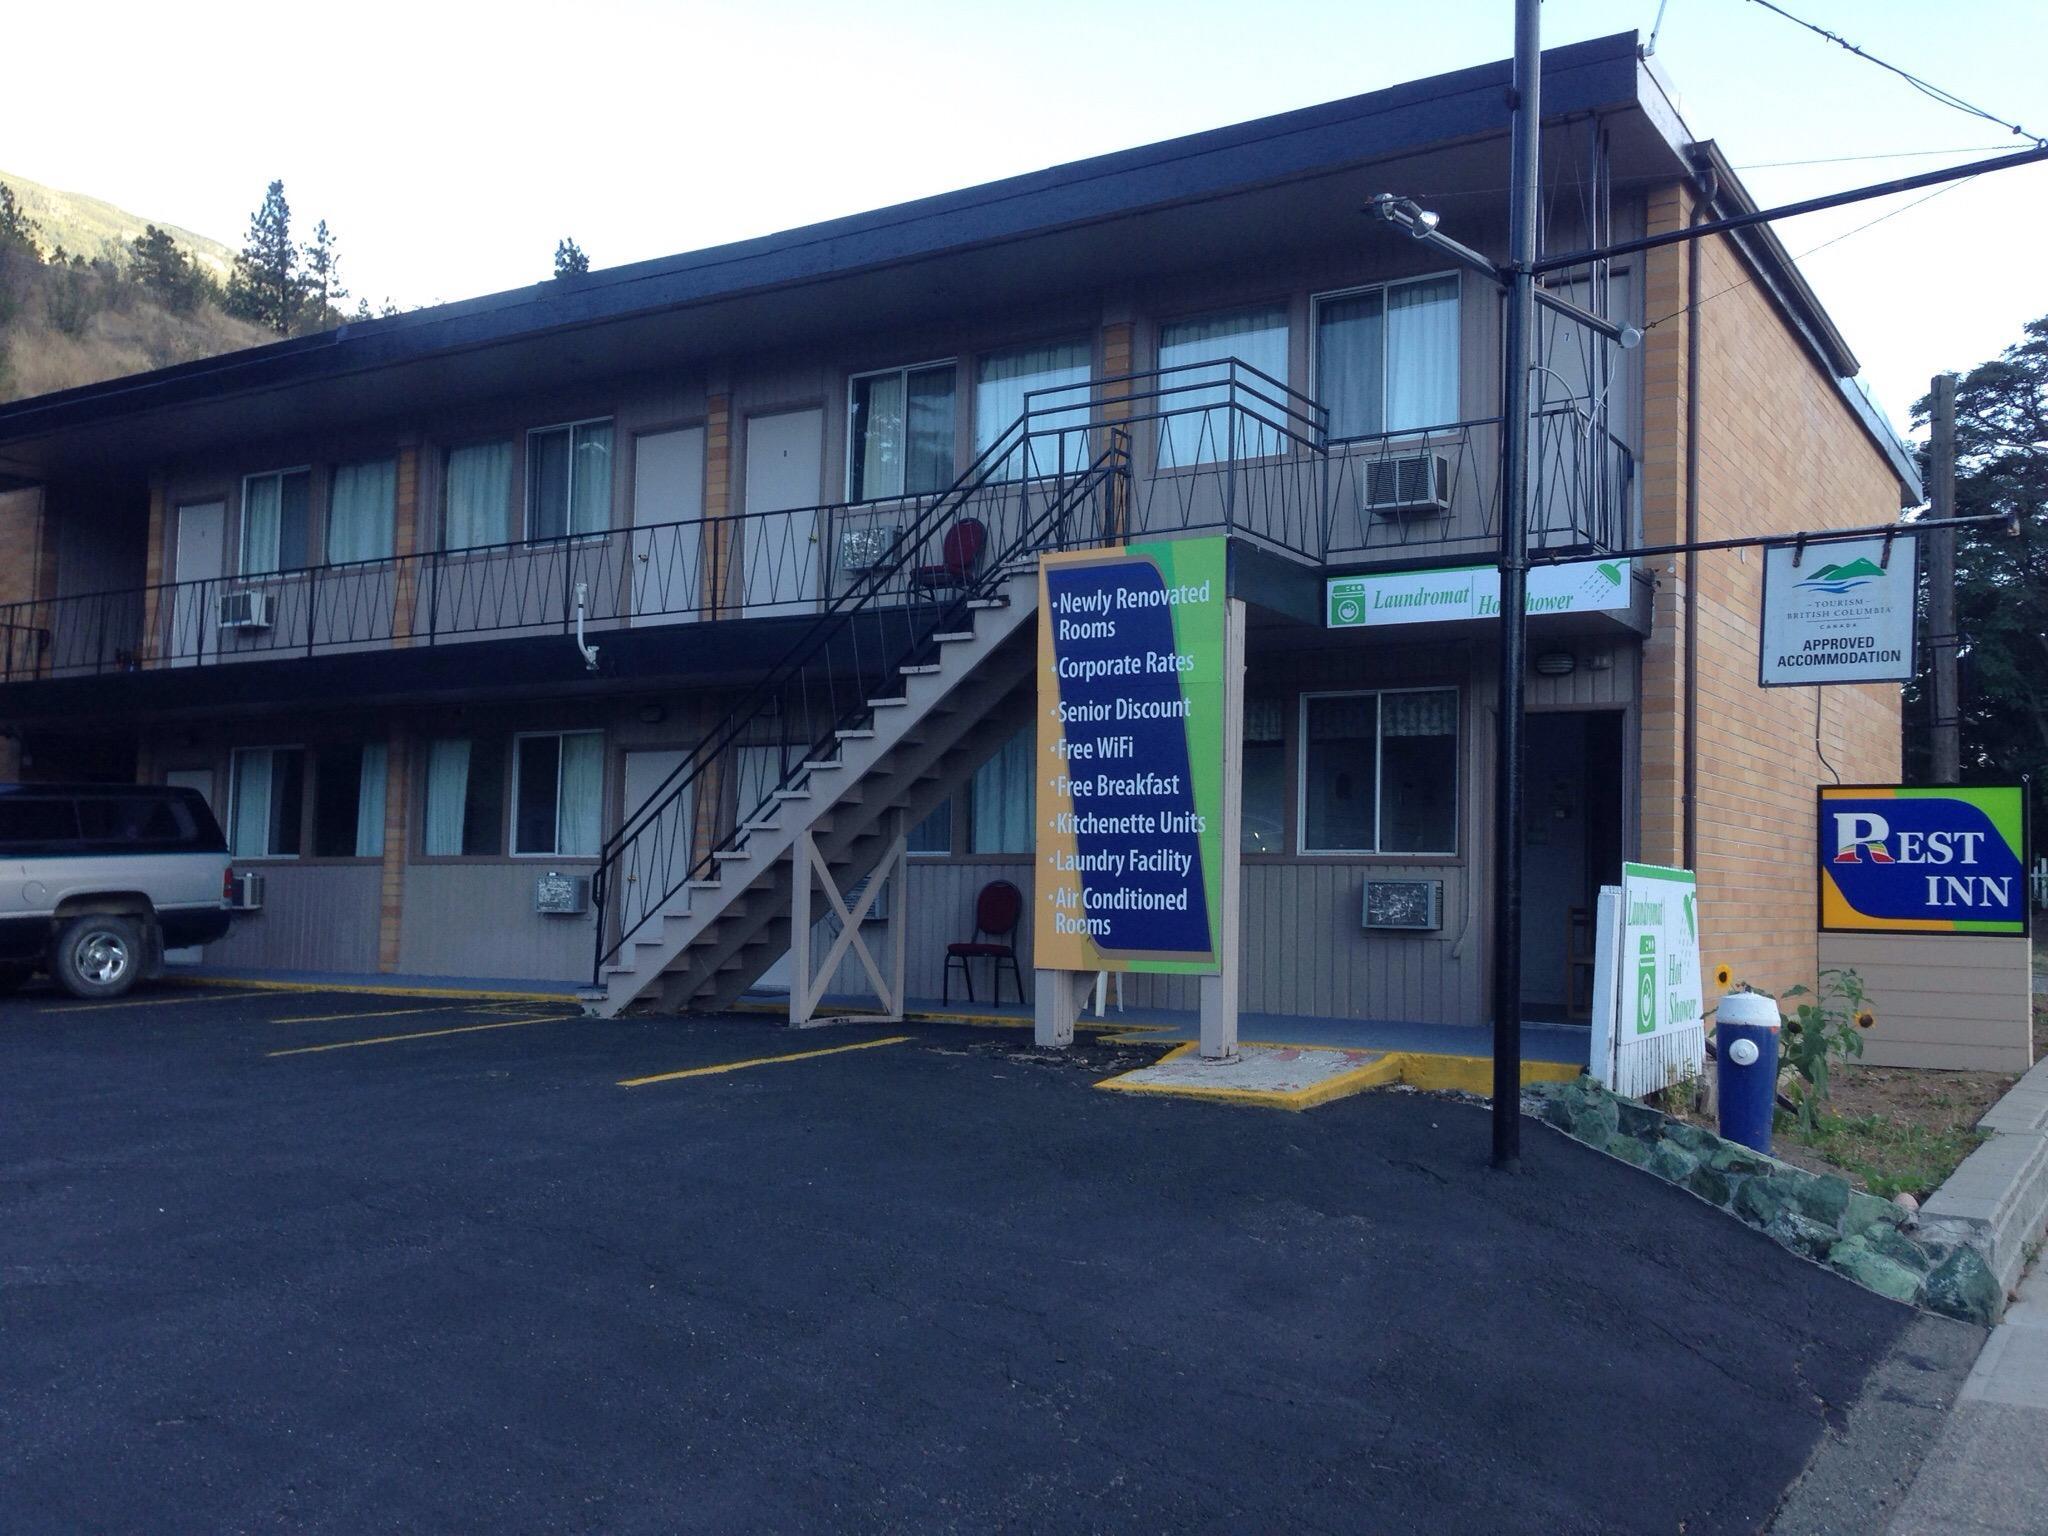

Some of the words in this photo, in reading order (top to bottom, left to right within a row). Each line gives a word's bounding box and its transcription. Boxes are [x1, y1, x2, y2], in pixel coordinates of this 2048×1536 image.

[1060, 589, 1112, 616] Newly
[1116, 580, 1210, 609] Renovated
[1374, 586, 1469, 609] Laundromat
[1478, 594, 1501, 614] Ho
[1525, 591, 1574, 611] hower
[1814, 598, 1863, 608] TOURISM
[1787, 610, 1830, 620] BRITISH
[1833, 606, 1891, 617] COLUMBIA
[1059, 619, 1115, 640] Rooms
[1803, 636, 1874, 651] APPROVED
[1059, 655, 1141, 682] Corporate
[1146, 651, 1194, 673] Rates
[1777, 650, 1901, 667] ACCOMMODATION
[1058, 700, 1112, 723] Senior
[1116, 697, 1191, 720] Discount
[1058, 738, 1093, 760] Free
[1097, 736, 1133, 759] WiFi
[1057, 776, 1093, 797] Free
[1097, 773, 1180, 797] Breakfast
[1056, 812, 1155, 834] Kitchenette
[1160, 811, 1206, 833] Units
[1833, 812, 1985, 864] REST
[1056, 849, 1125, 877] Laundry
[1129, 849, 1192, 877] Facility
[1055, 887, 1079, 909] Air
[1083, 887, 1187, 910] Conditioned
[1925, 876, 2013, 907] INN
[1055, 912, 1111, 935] Rooms
